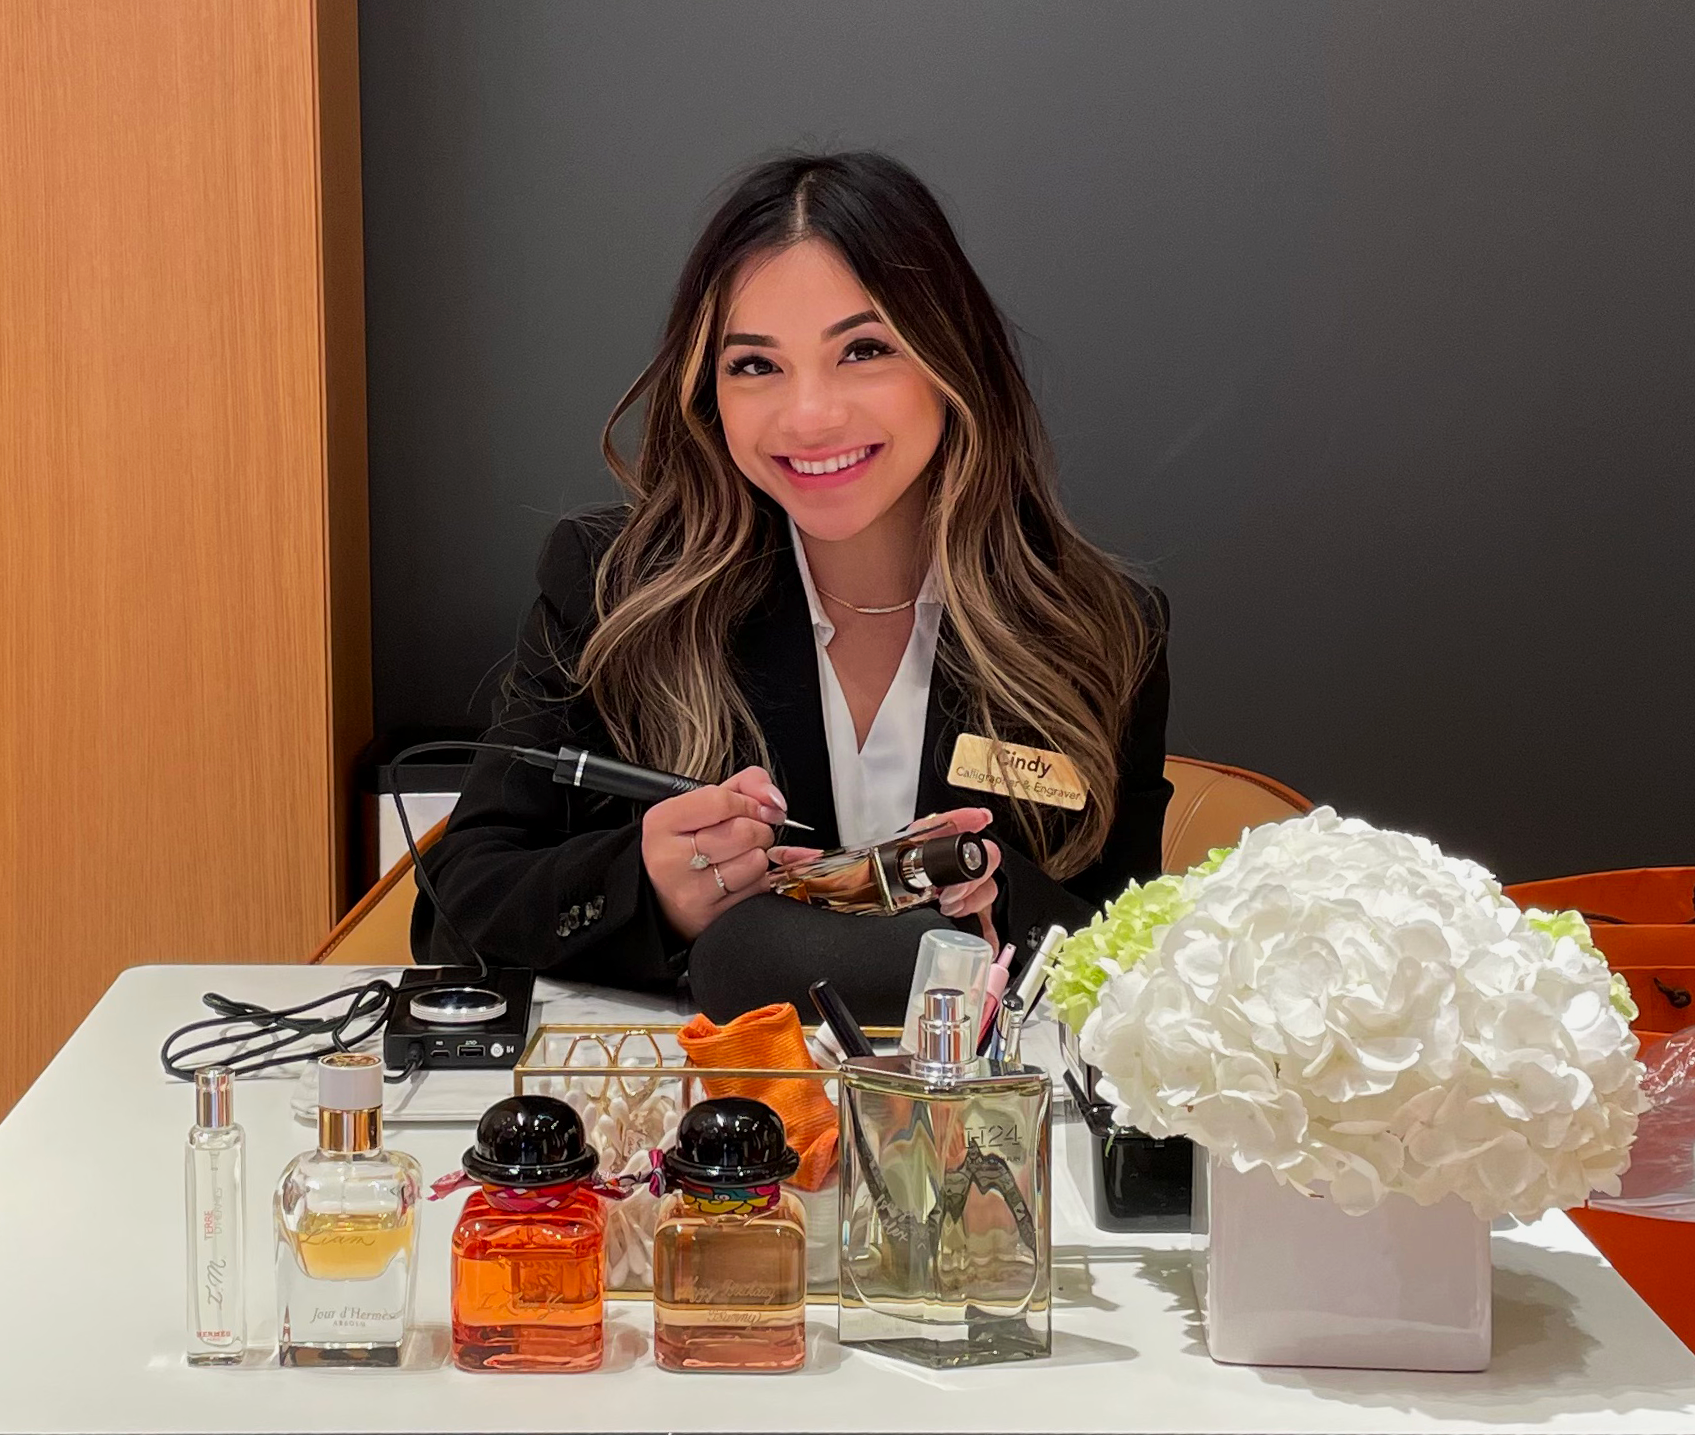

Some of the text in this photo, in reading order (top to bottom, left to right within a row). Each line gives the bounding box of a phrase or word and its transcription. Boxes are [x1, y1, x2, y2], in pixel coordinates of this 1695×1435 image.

[955, 766, 1020, 788] Calligraper
[1033, 782, 1082, 801] Engraver
[965, 1124, 1023, 1149] H24
[204, 1210, 214, 1241] TERRE
[300, 1227, 376, 1246] Liam
[310, 1308, 335, 1323] Jour
